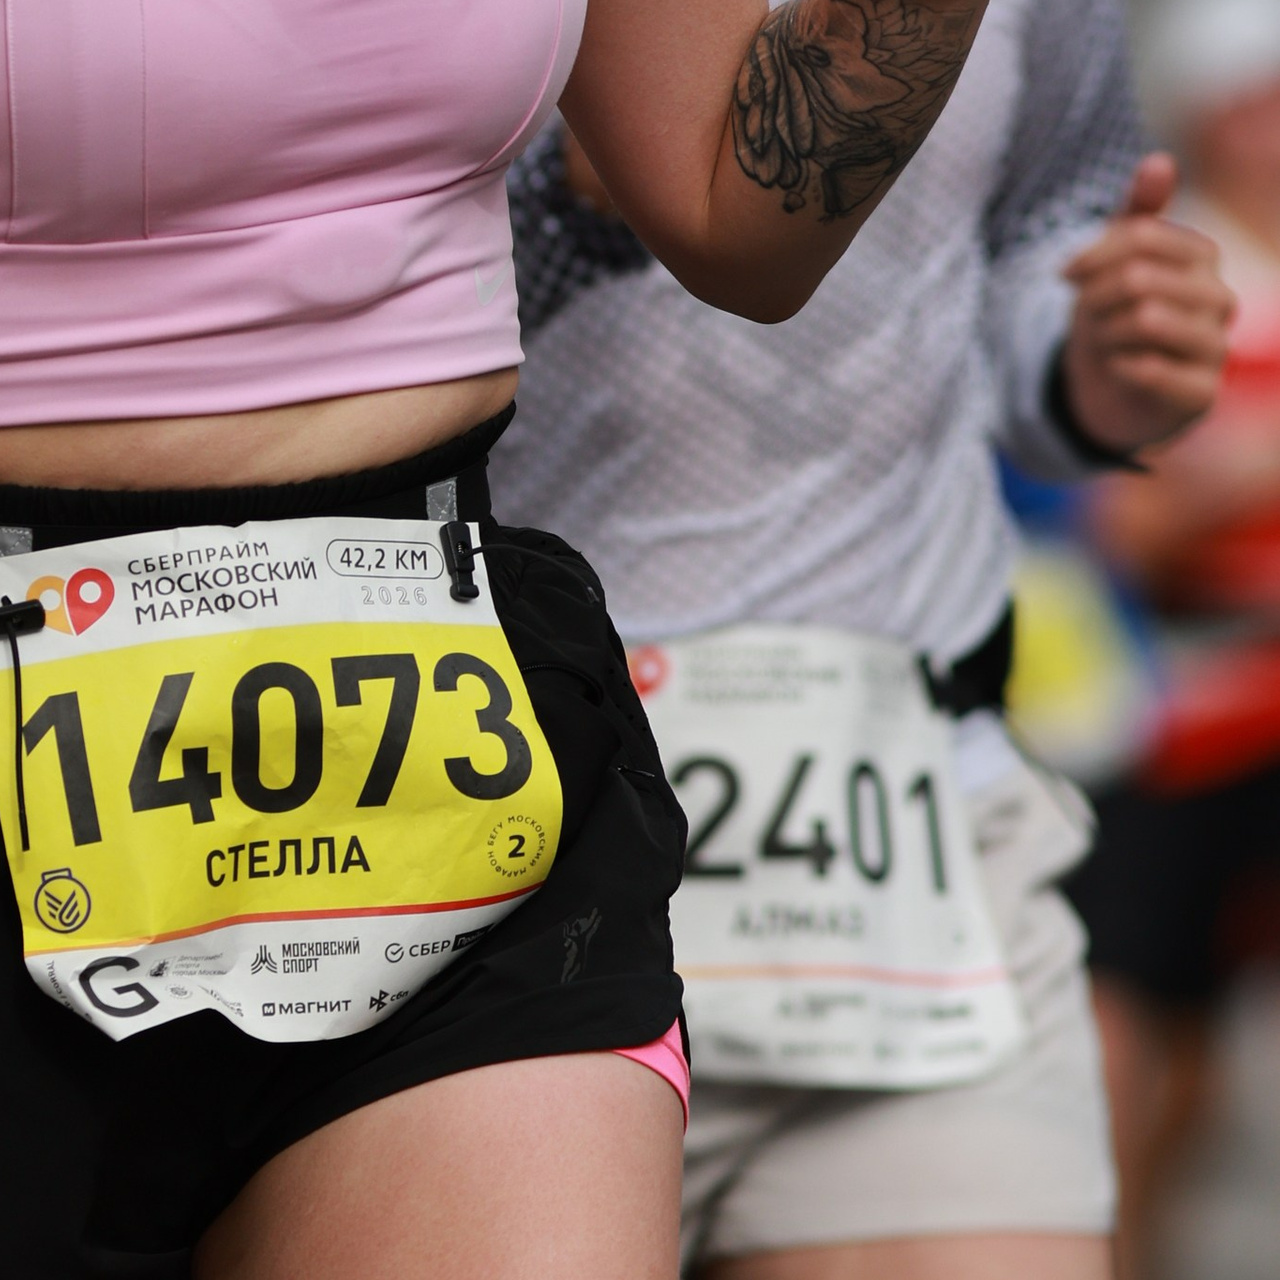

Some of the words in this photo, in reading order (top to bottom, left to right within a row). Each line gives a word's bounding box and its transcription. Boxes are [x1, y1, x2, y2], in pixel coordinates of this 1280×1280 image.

[127, 540, 270, 576] СБЕРПРАЙМ
[340, 547, 386, 572] 42,2
[396, 549, 428, 571] КМ
[131, 557, 318, 601] МОСКОВСКИЙ
[361, 586, 428, 606] 2026
[135, 587, 279, 625] МАРАФОН
[22, 652, 532, 848] 14073
[670, 748, 948, 894] 2401
[206, 835, 372, 888] СТЕЛЛА
[508, 834, 526, 859] 2
[282, 937, 361, 958] МОСКОВСКИЙ
[409, 940, 451, 958] СБЕР
[283, 958, 320, 974] СПОРТ
[78, 956, 160, 1018] G
